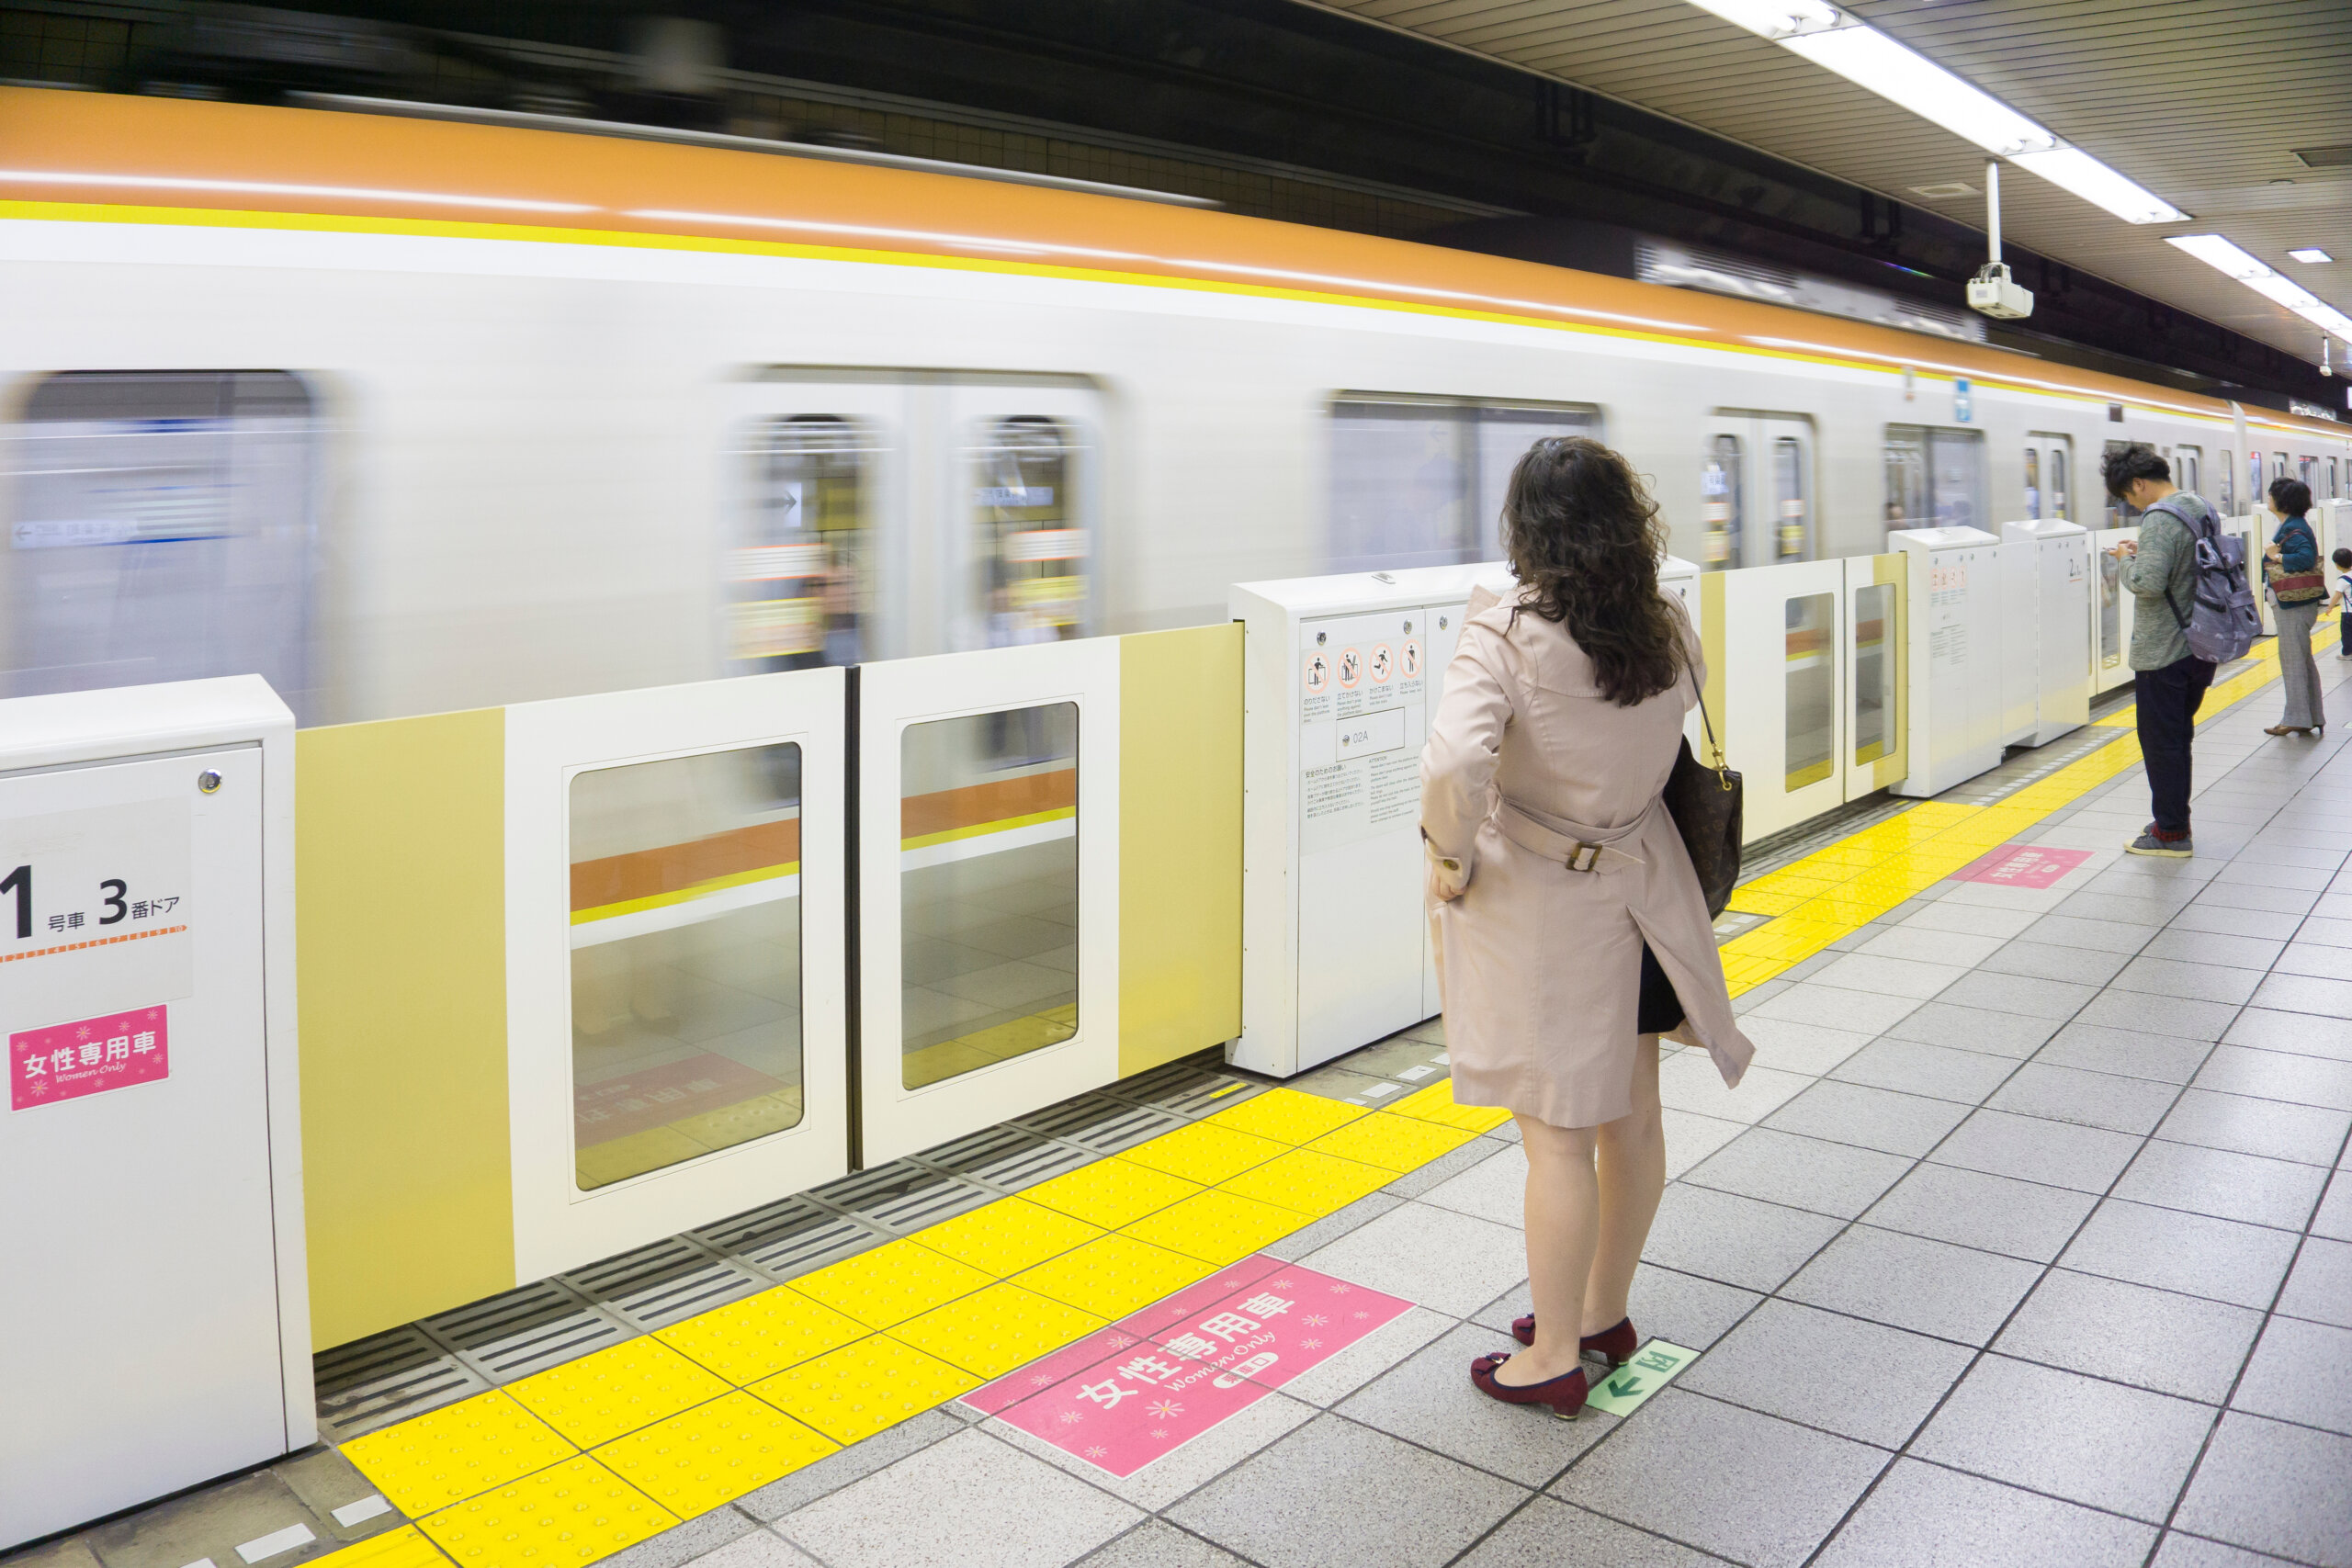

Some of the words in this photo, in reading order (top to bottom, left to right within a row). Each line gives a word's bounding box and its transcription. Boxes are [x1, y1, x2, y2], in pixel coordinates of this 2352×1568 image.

[1353, 730, 1368, 743] 02A
[0, 864, 32, 940] 1
[48, 911, 85, 933] 号車
[98, 878, 128, 925] 3
[131, 897, 180, 919] 番ドア
[23, 1031, 156, 1078] 女性専用車
[55, 1068, 97, 1083] Women
[99, 1061, 127, 1073] Only
[1076, 1292, 1295, 1410] 女性専用車
[1163, 1353, 1236, 1392] Women
[1233, 1331, 1276, 1355] Only
